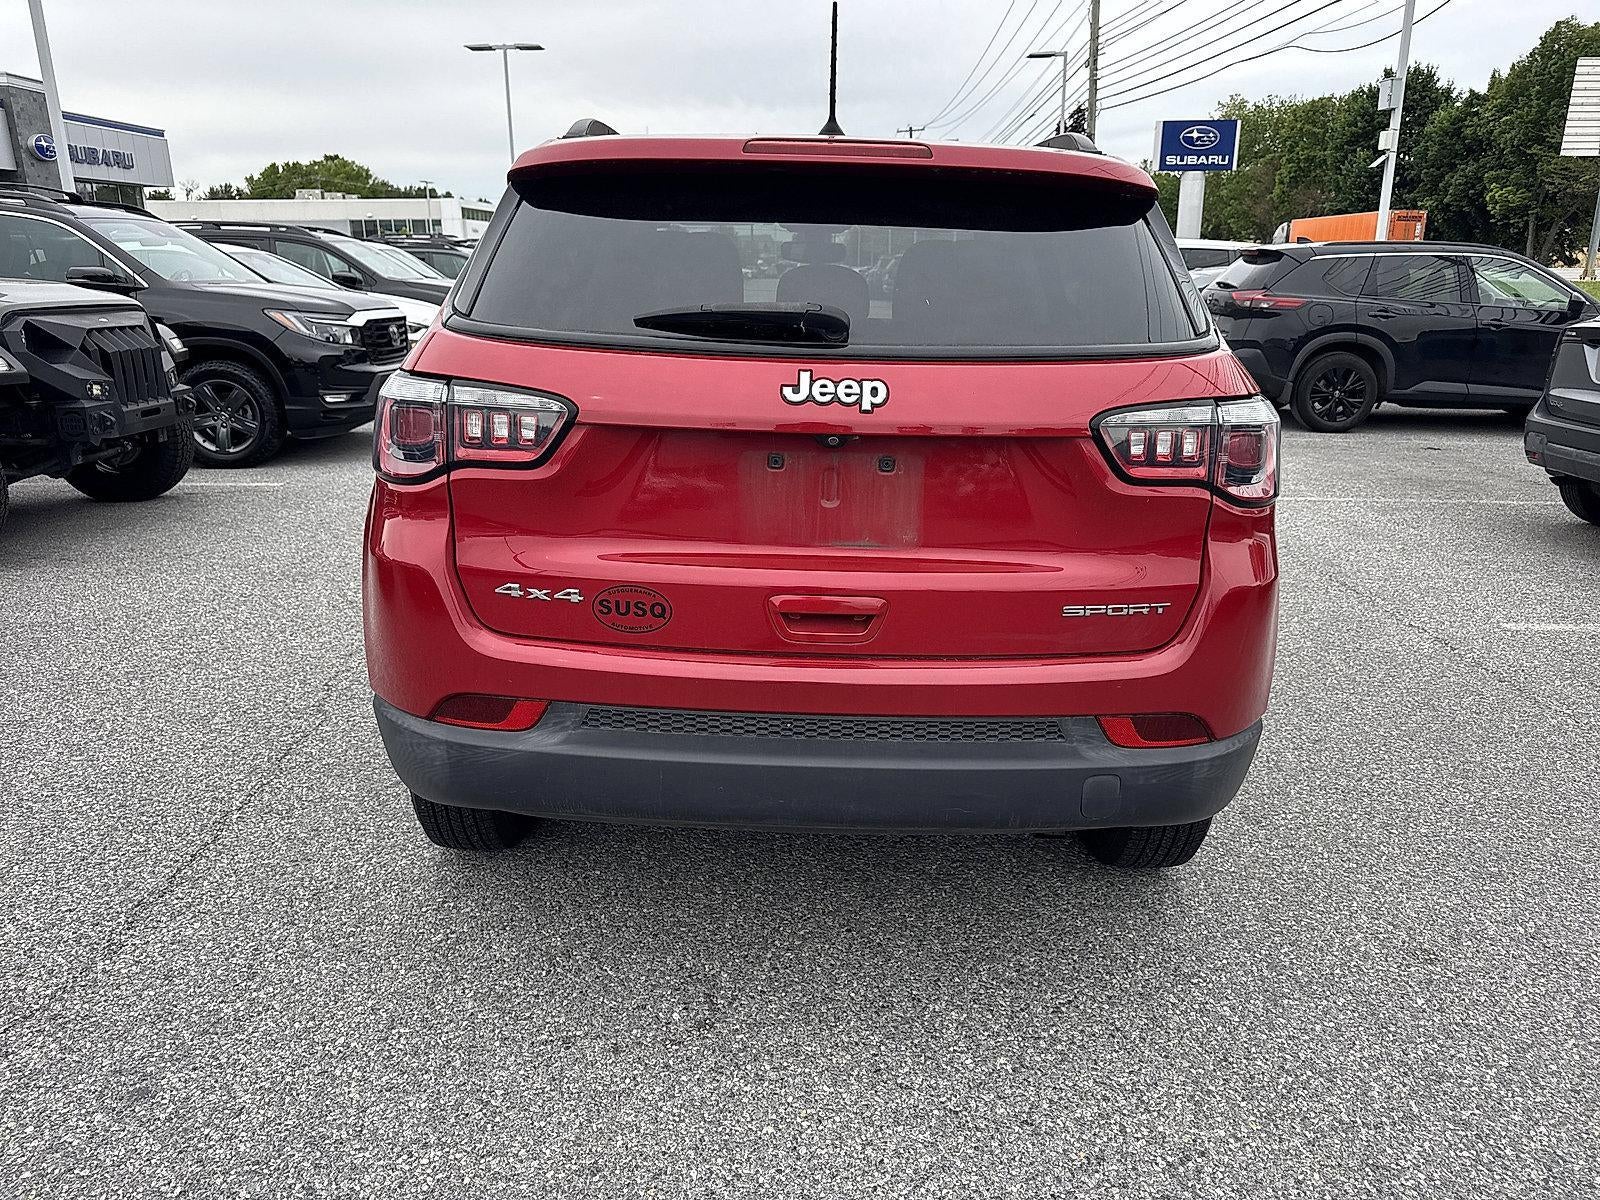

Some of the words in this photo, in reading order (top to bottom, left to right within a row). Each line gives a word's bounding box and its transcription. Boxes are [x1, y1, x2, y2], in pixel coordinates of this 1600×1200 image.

[1165, 155, 1230, 165] SUBARU
[781, 369, 889, 413] Jeep
[494, 582, 585, 603] 4x4
[598, 598, 667, 621] SUSQ
[1061, 602, 1172, 617] SPORT
[610, 621, 654, 631] AUTOMOTIVE
